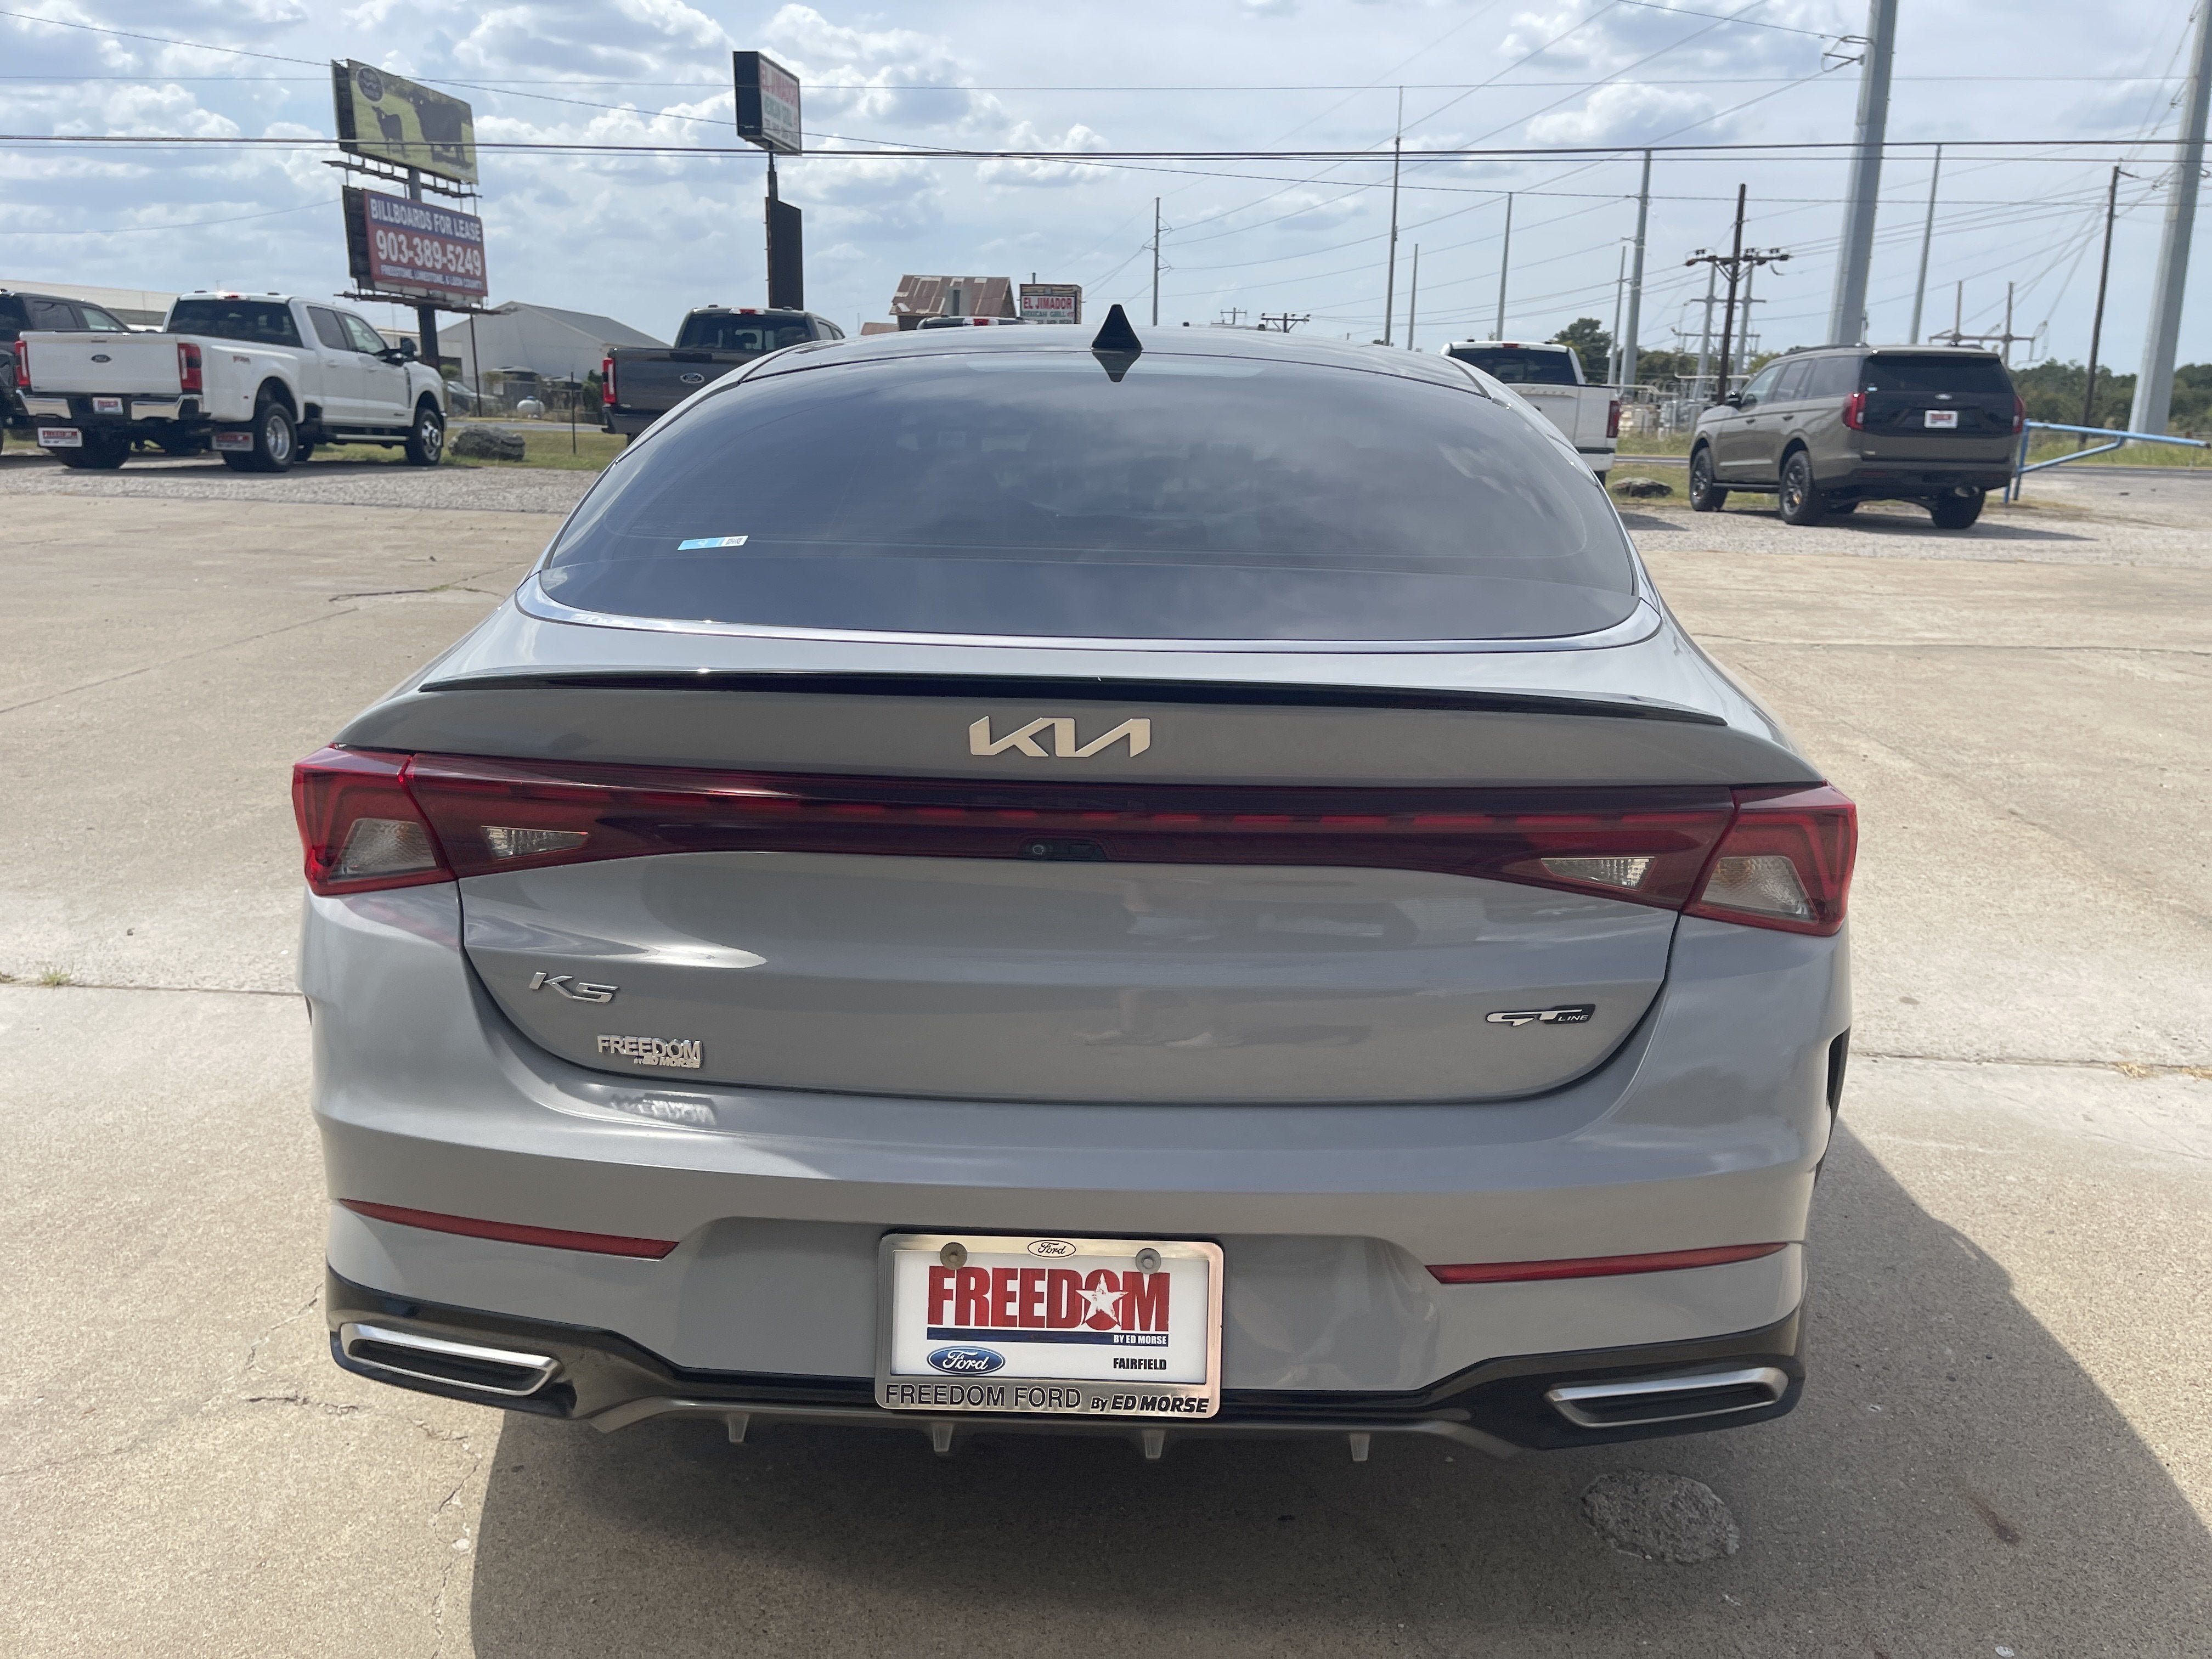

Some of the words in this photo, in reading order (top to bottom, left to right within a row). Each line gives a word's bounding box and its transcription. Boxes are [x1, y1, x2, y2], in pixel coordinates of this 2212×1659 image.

[370, 198, 432, 231] BILLBOARDS
[433, 213, 453, 235] FOR
[453, 218, 481, 242] LEASE
[376, 229, 482, 276] 903-389-5249
[1023, 297, 1033, 309] EL
[1035, 297, 1072, 309] JIMADOR
[969, 715, 1150, 758] KIA
[529, 972, 619, 1003] K5
[1487, 1009, 1582, 1026] GT
[597, 1034, 702, 1060] FREEDOM
[1038, 1242, 1066, 1255] Ford
[928, 1266, 1170, 1332] FREEDOM
[1113, 1334, 1125, 1344] BY
[1126, 1335, 1136, 1344] ED
[1138, 1335, 1167, 1345] MORSE
[943, 1350, 990, 1370] Ford
[1113, 1358, 1167, 1370] FAIRFIELD
[885, 1384, 1005, 1407] FREEDOM
[1015, 1386, 1082, 1408] FORD
[1111, 1395, 1137, 1411] ED
[1139, 1396, 1210, 1413] MORSE
